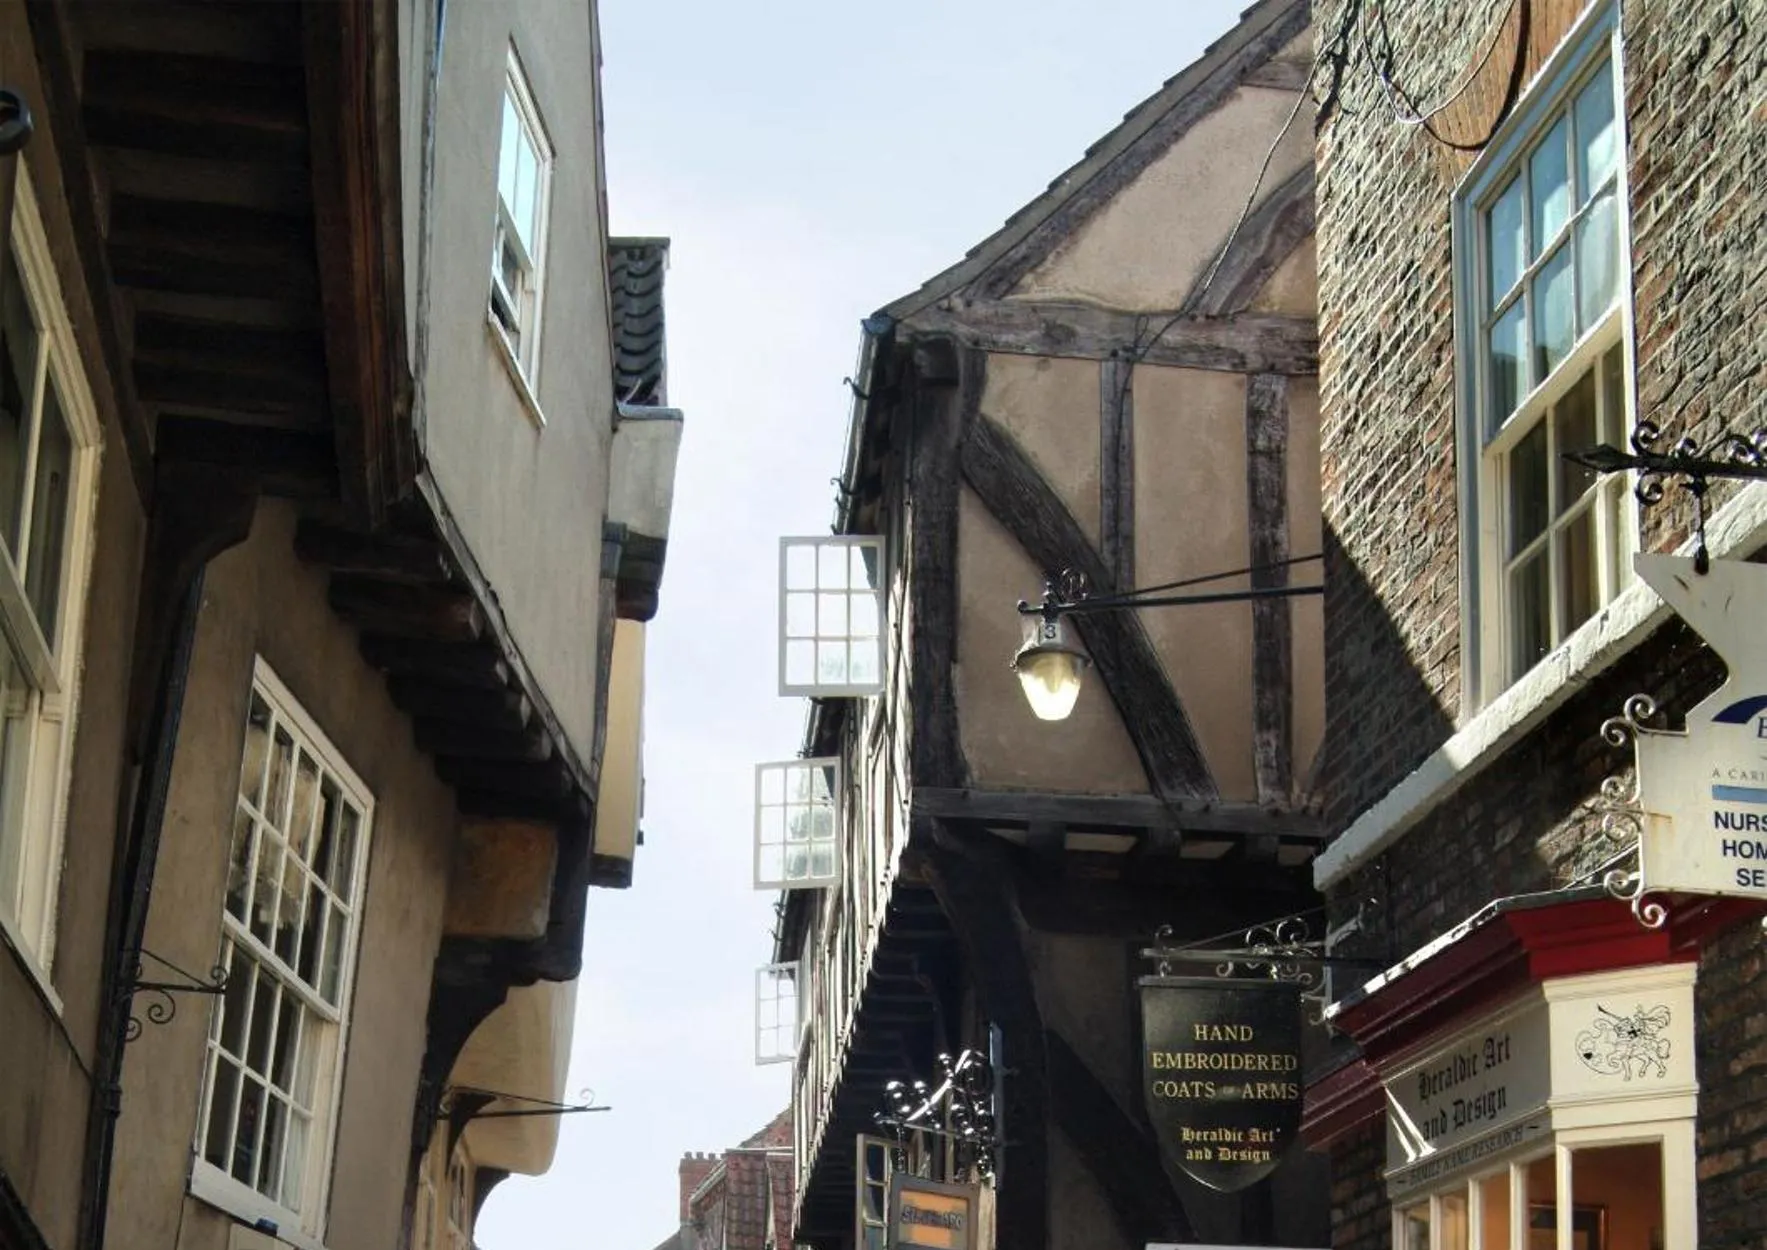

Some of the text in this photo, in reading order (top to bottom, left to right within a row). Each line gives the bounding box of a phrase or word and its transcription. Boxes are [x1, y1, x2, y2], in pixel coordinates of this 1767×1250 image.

[1714, 811, 1767, 832] NURS
[1736, 868, 1766, 887] SE
[1194, 1024, 1253, 1041] HAND
[1152, 1052, 1298, 1072] EMBROIDERED
[1418, 1034, 1511, 1105] Heraldic Art
[1152, 1080, 1216, 1098] COATS
[1242, 1082, 1299, 1099] ARMS
[1422, 1086, 1507, 1141] and Design
[1180, 1127, 1275, 1144] Heraldic Art
[1186, 1147, 1271, 1164] and Design
